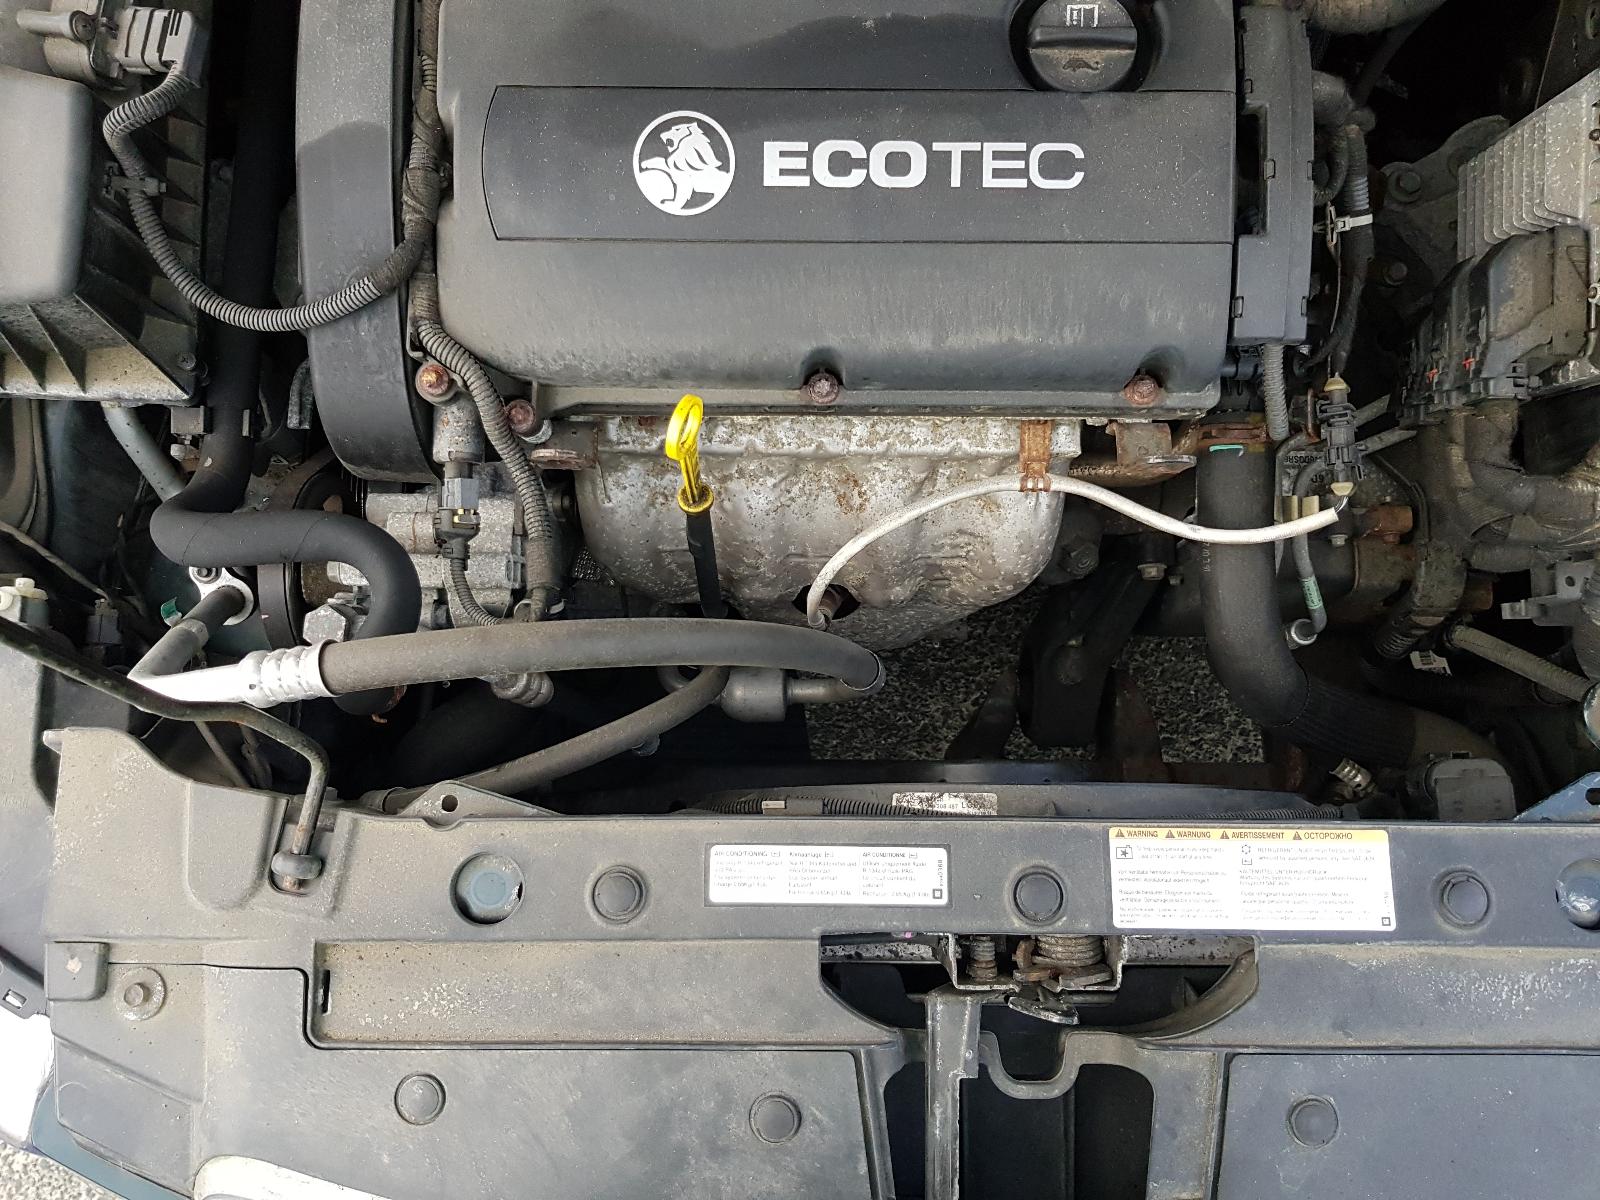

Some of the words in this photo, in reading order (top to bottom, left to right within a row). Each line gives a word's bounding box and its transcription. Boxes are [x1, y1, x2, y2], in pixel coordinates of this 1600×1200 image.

[763, 139, 1086, 190] ECOTEC
[1126, 830, 1159, 838] WARNING
[1176, 830, 1211, 839] WARNUNG
[1231, 831, 1285, 840] AVERTISSEMENT
[1303, 832, 1353, 840] ОСТОРОЖНО
